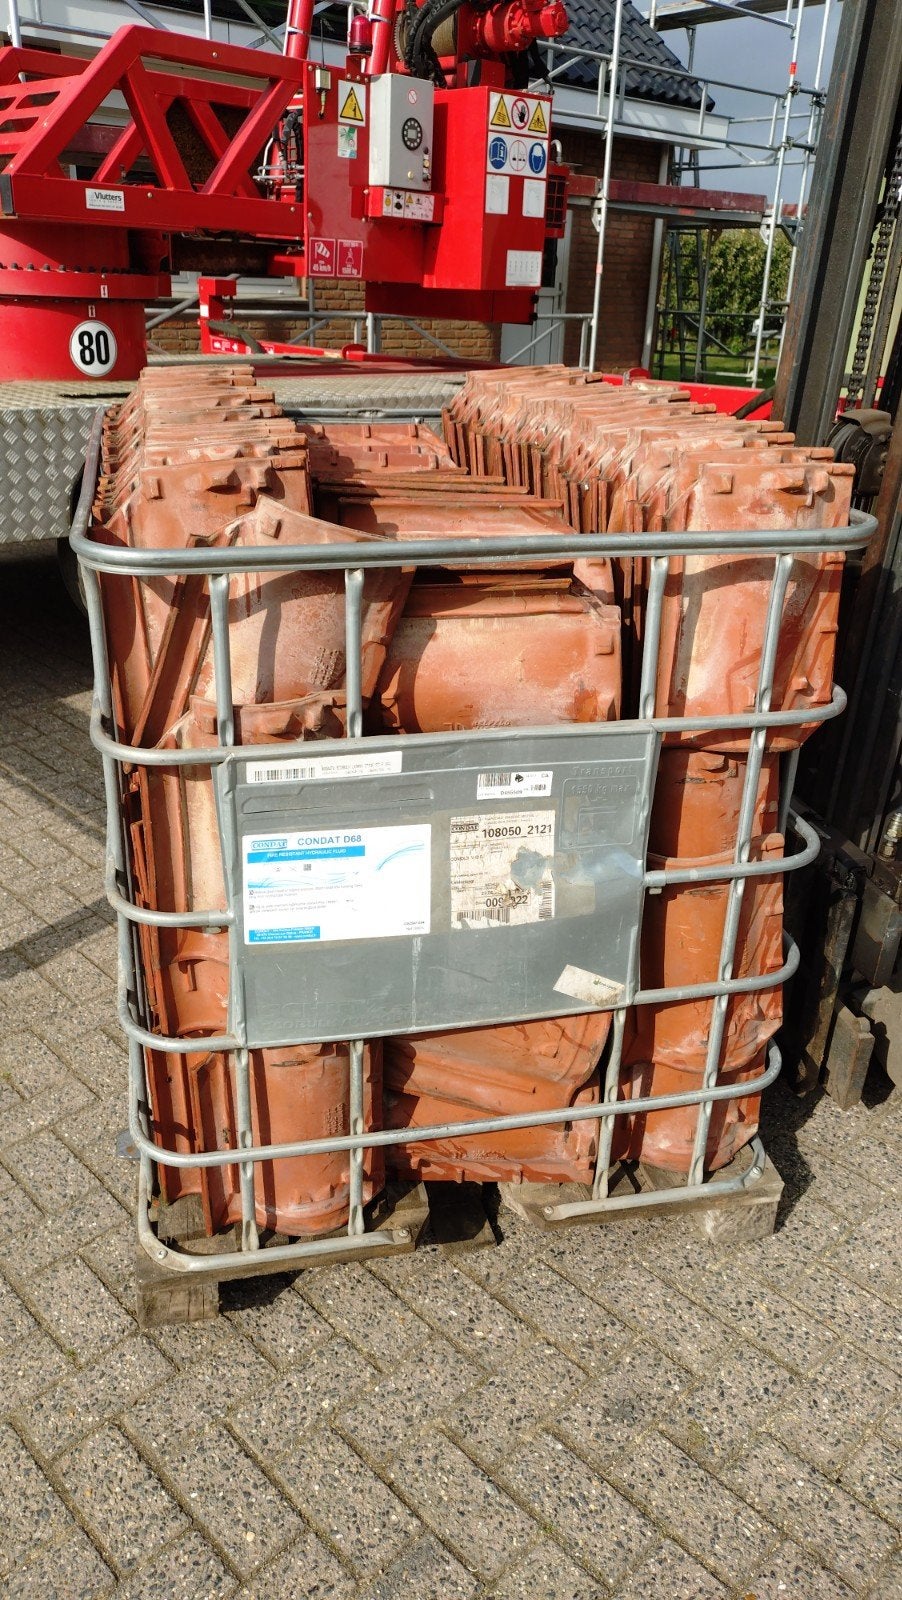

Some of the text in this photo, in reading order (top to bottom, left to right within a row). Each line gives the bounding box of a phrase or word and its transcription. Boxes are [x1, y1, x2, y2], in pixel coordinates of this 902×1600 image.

[94, 192, 122, 202] Vlutters
[78, 330, 110, 366] 80
[482, 824, 552, 839] 108050_2121
[252, 835, 362, 849] CONDAT CONDAT D68
